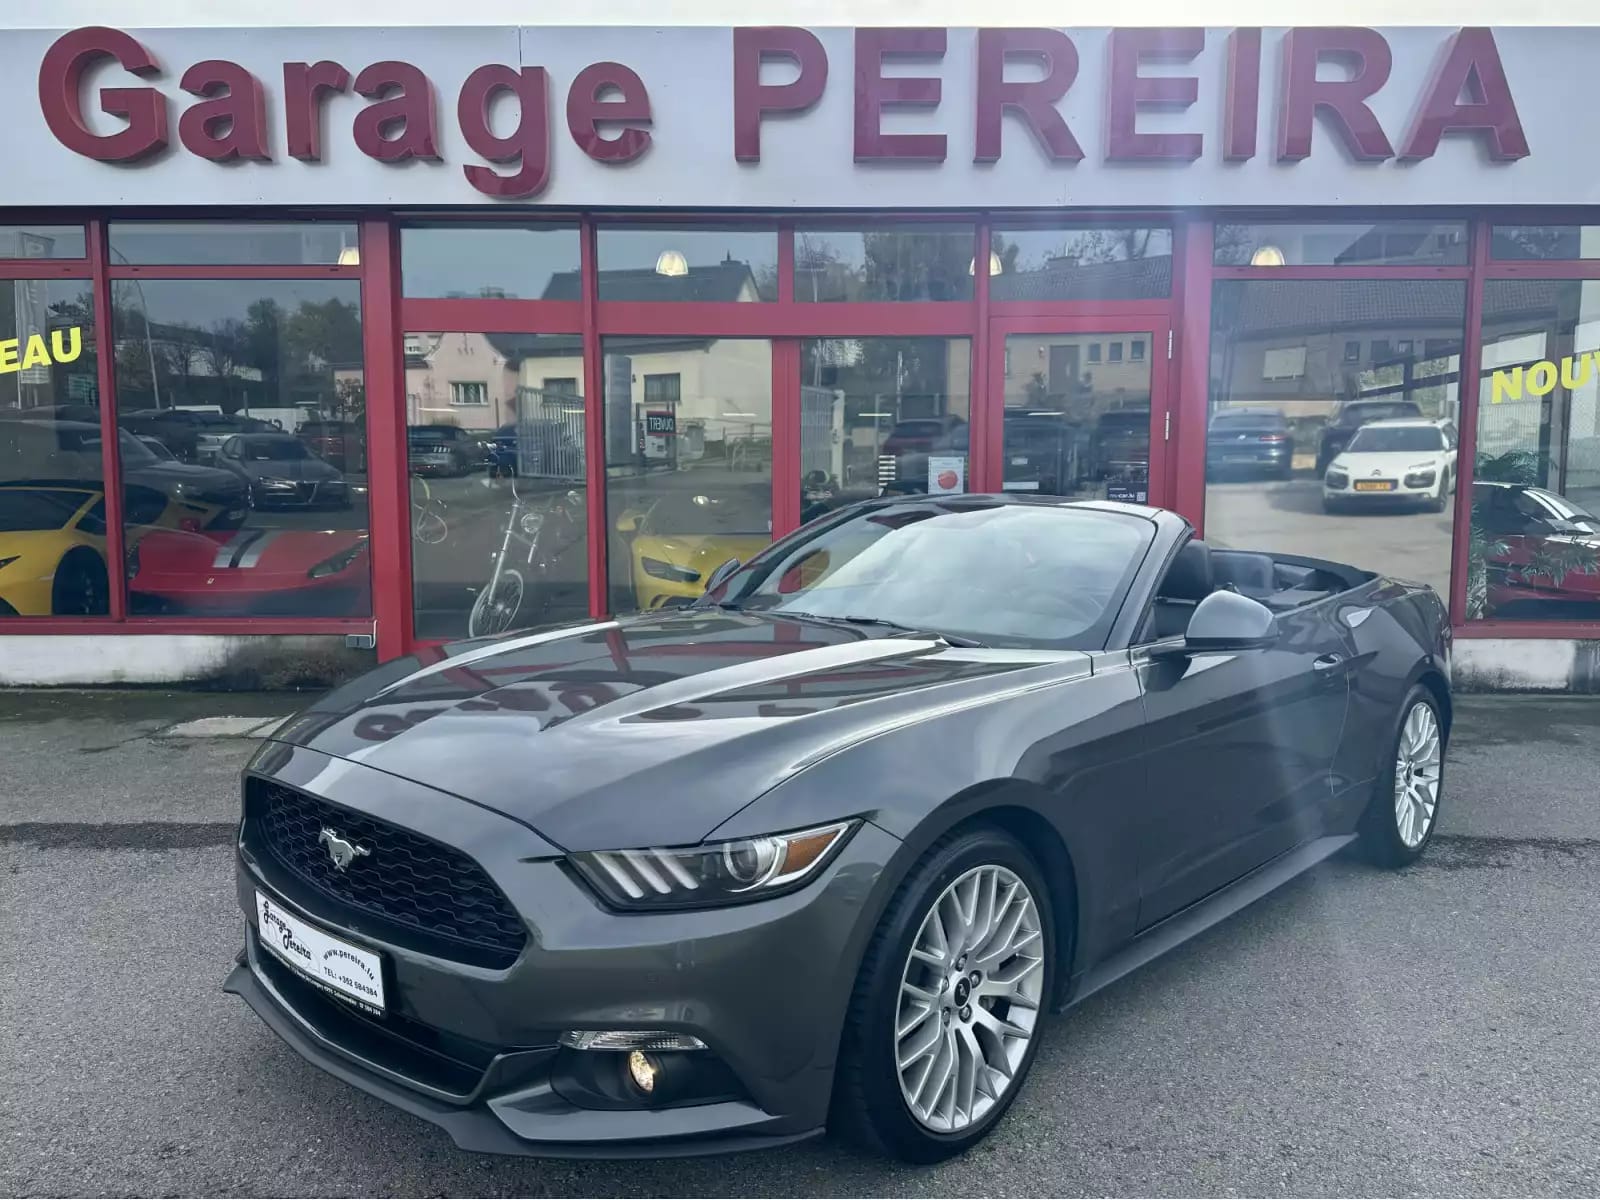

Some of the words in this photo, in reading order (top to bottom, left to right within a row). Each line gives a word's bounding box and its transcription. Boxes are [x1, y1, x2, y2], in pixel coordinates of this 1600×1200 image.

[38, 26, 652, 200] Garage
[733, 26, 1531, 163] PEREIRA
[0, 326, 82, 374] EAU
[263, 900, 287, 934] Garage
[282, 927, 312, 961] Pereira
[323, 966, 337, 980] TEL:
